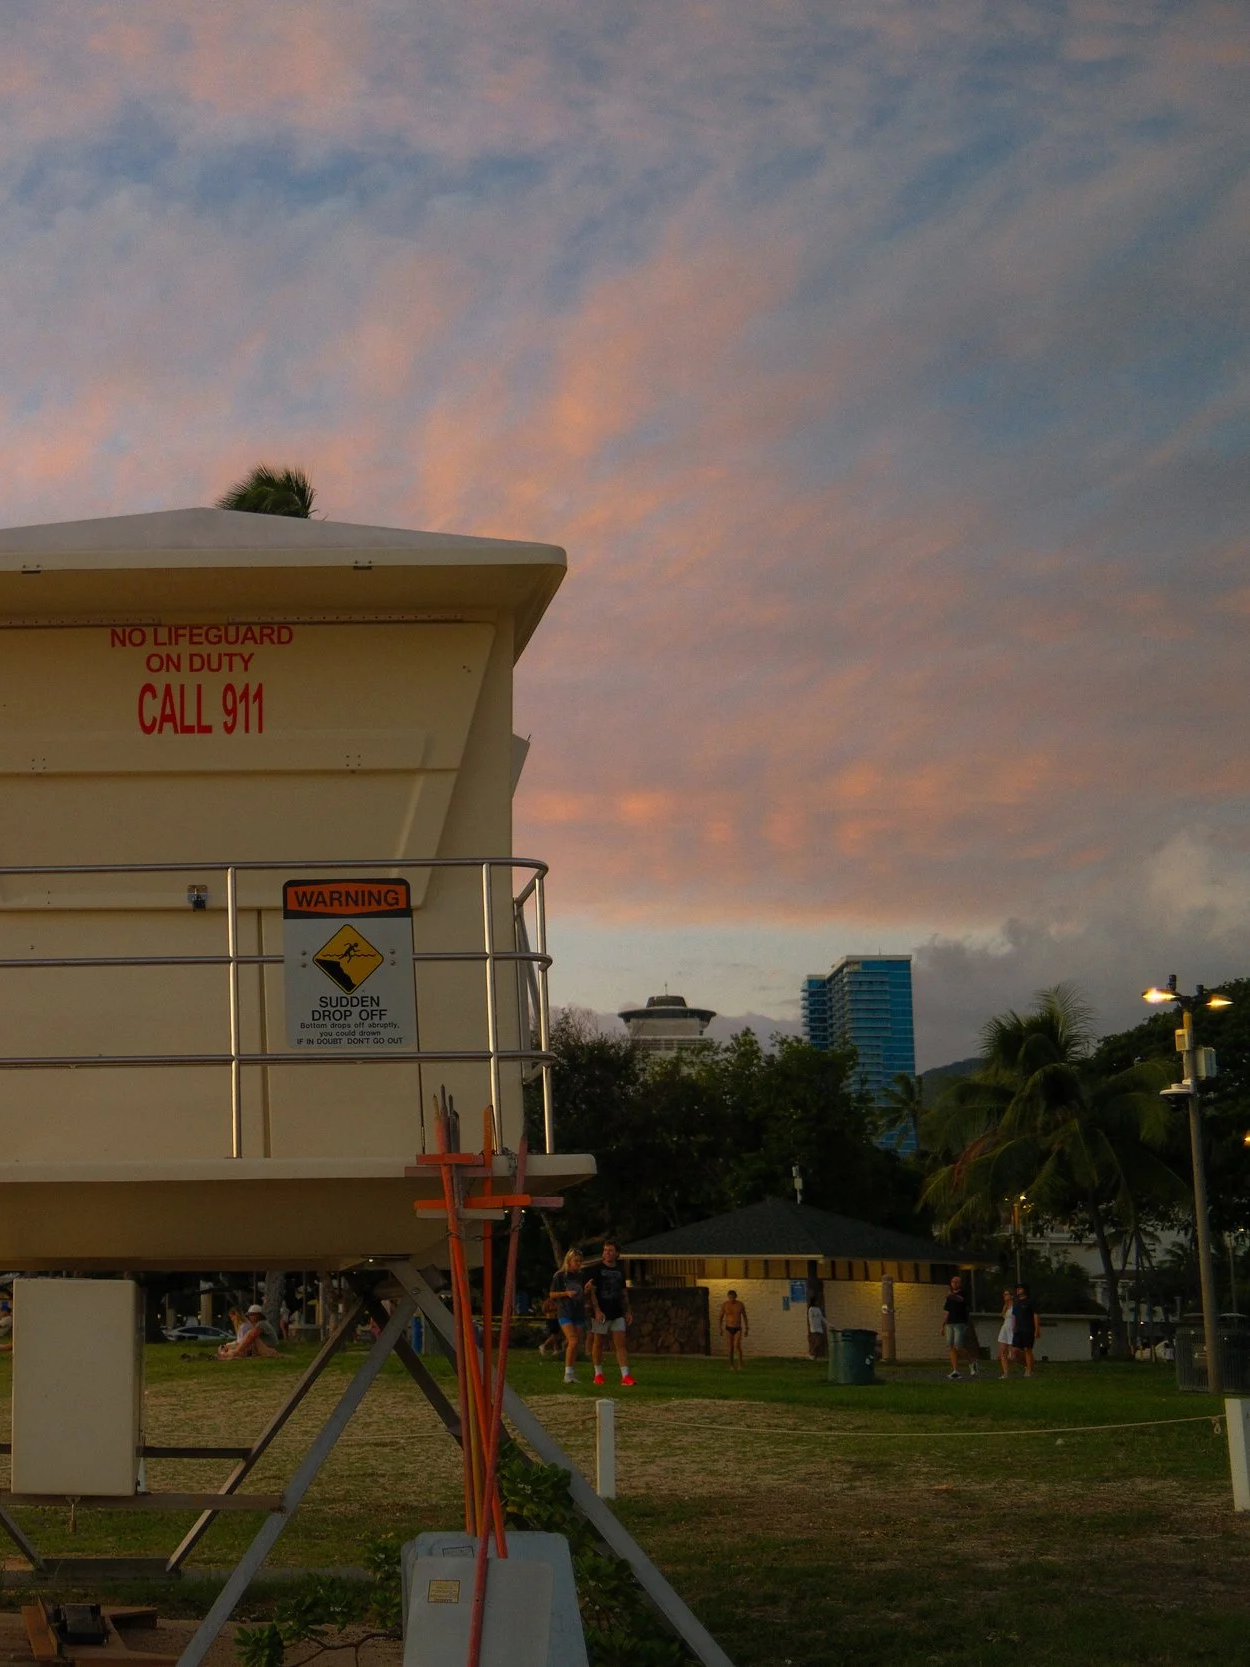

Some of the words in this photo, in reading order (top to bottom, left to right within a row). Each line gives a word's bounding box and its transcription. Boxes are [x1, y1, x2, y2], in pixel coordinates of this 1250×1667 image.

[110, 627, 147, 648] NO
[153, 625, 294, 647] LIFEGUARD
[145, 653, 182, 674] ON
[188, 652, 255, 673] DUTY
[137, 682, 213, 735] CALL
[222, 682, 264, 735] 911
[294, 889, 400, 908] WARNING
[319, 996, 380, 1008] SUDDEN
[311, 1009, 352, 1022] DROP
[359, 1009, 387, 1021] OFF
[330, 1022, 351, 1030] drops
